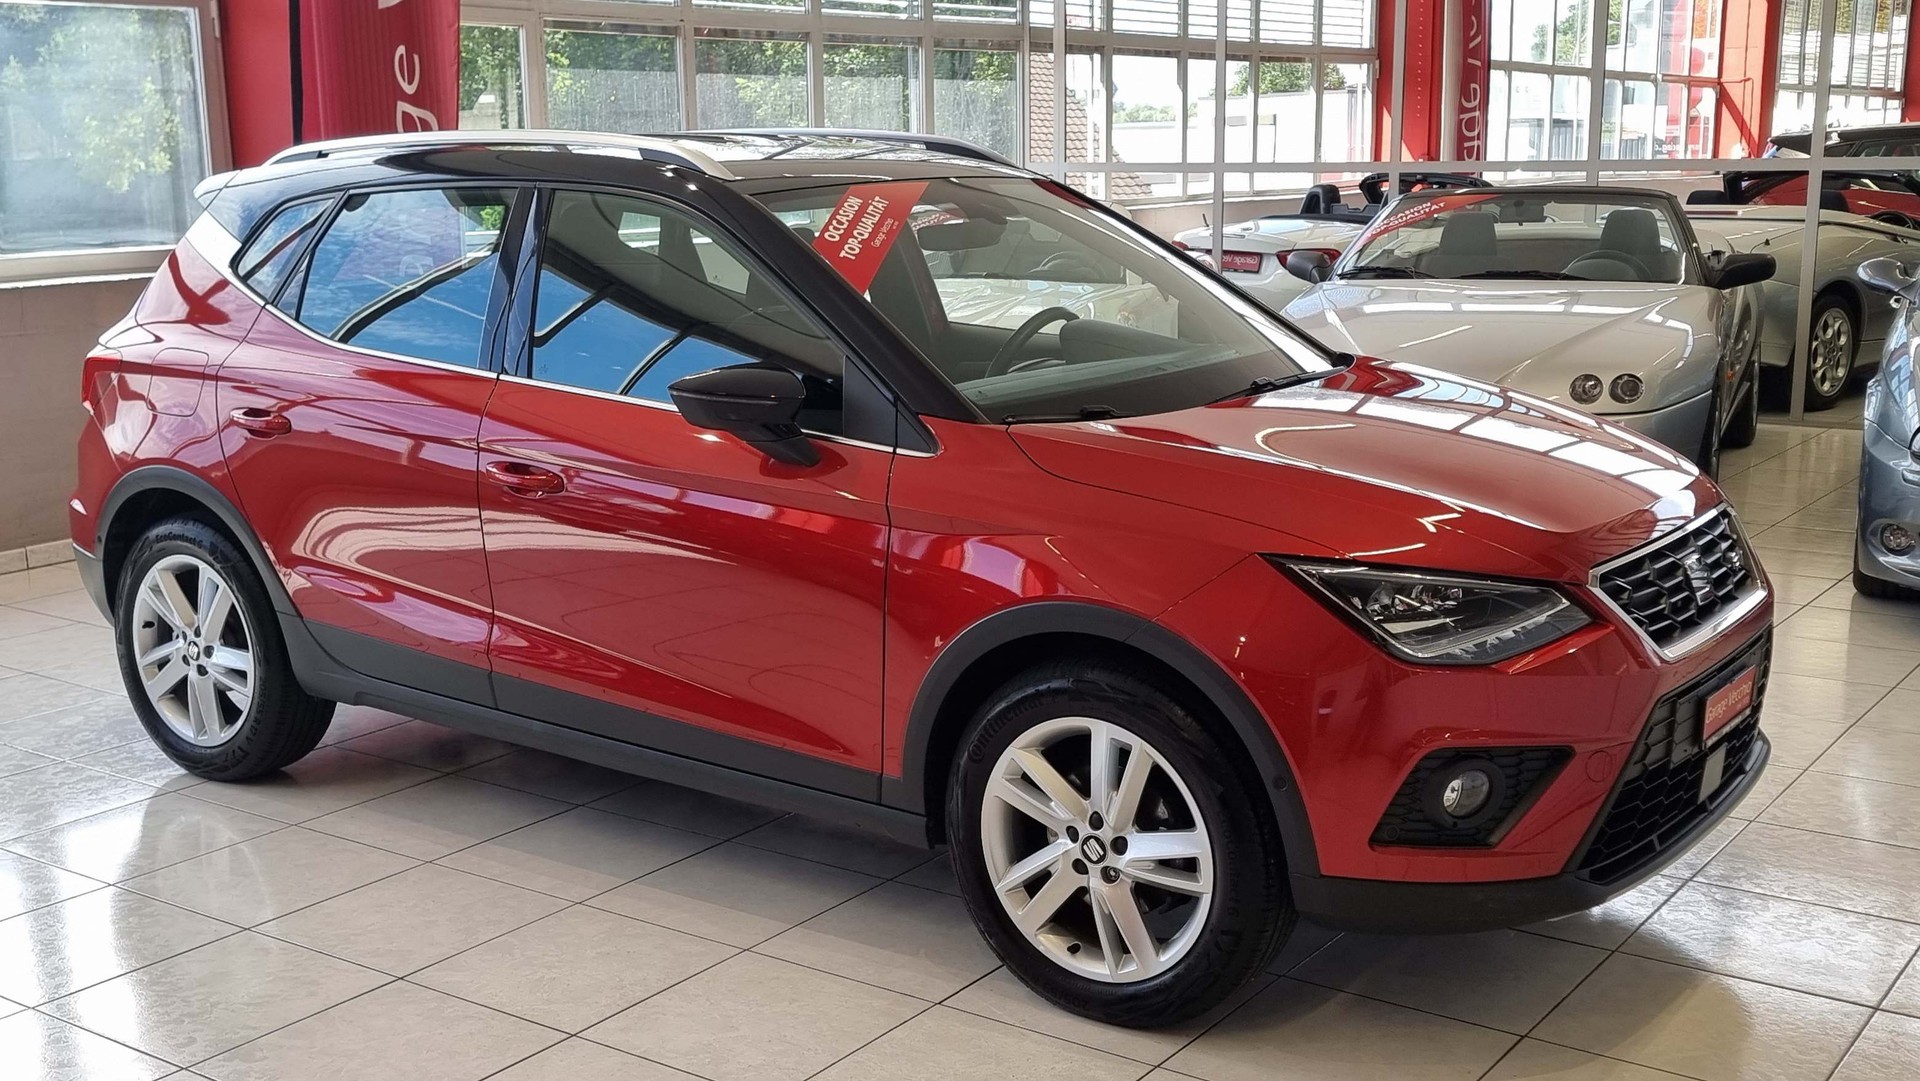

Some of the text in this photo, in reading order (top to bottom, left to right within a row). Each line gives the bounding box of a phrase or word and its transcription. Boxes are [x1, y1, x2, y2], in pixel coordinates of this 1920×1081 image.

[824, 195, 864, 242] OCCASION
[839, 196, 889, 261] TOP-QUALITÄT
[1377, 202, 1431, 228] OCCASION
[871, 230, 887, 248] Garage
[155, 530, 197, 546] EcoContact
[1706, 698, 1728, 724] Garage
[1728, 681, 1752, 706] Vecchio
